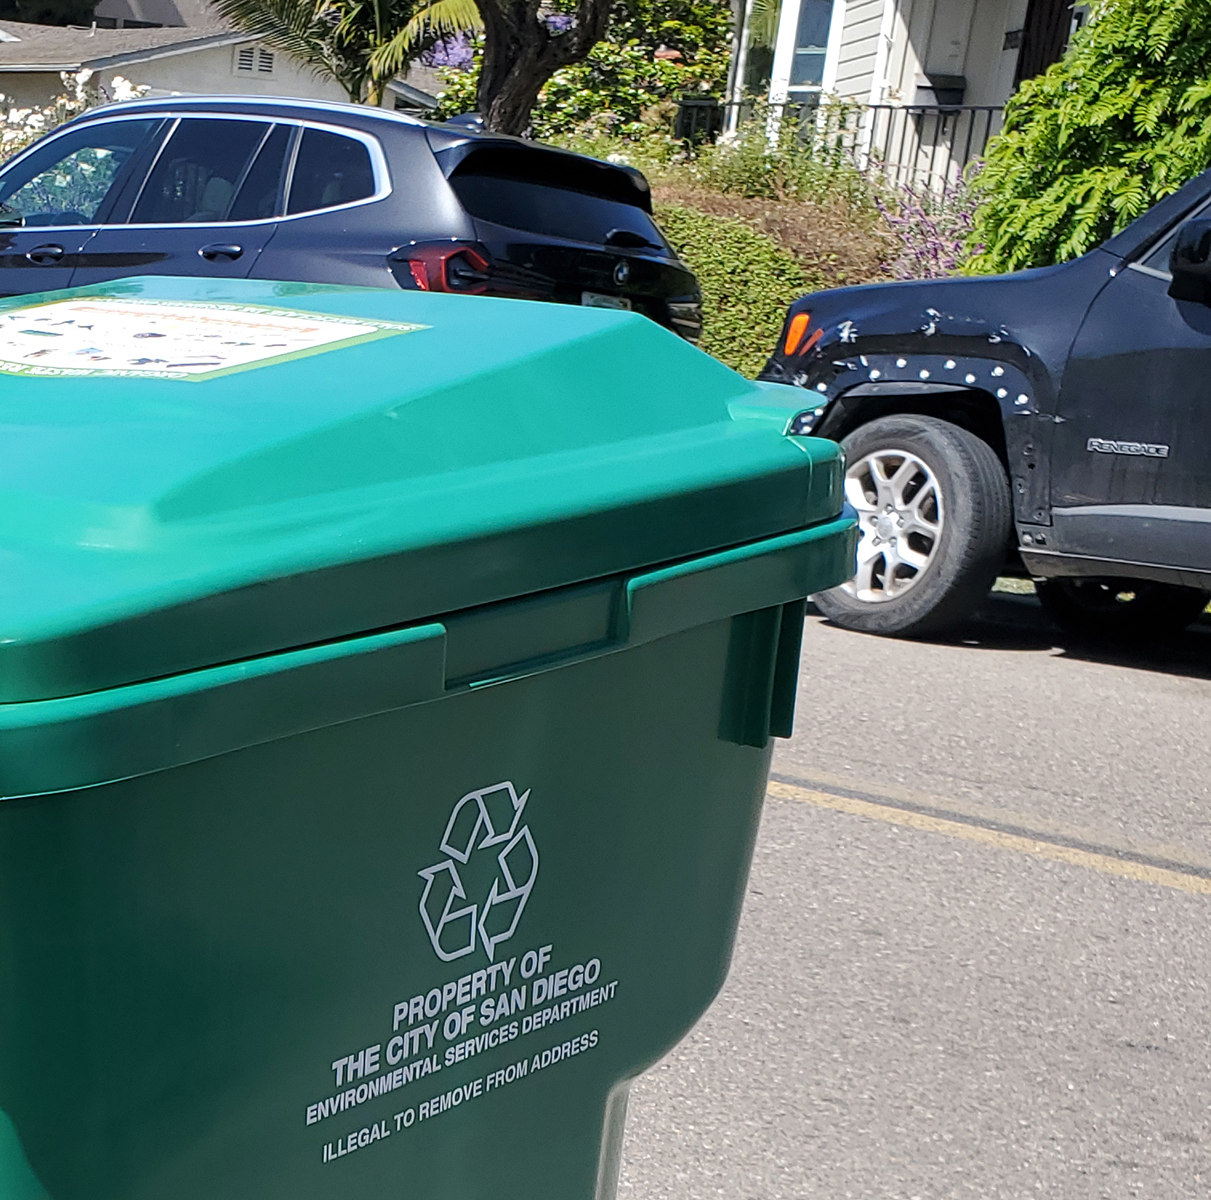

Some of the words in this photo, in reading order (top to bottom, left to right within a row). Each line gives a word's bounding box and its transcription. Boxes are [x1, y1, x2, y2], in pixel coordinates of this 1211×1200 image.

[1087, 438, 1169, 457] RENEGADE
[332, 1044, 381, 1087] THE
[386, 1020, 439, 1066] CITY
[443, 1005, 476, 1041] OF
[479, 986, 527, 1026] SAN
[532, 958, 601, 1003] DIEGO
[392, 957, 516, 1032] PROPERTY
[520, 944, 553, 979] OF
[306, 1054, 441, 1126] ENVIRONMENTAL
[444, 1021, 518, 1066] SERVICES
[522, 981, 618, 1035] DEPARTMENT
[322, 1120, 390, 1164] ILLEGAL
[394, 1108, 415, 1132] TO
[419, 1078, 482, 1122] REMOVE
[486, 1059, 528, 1092] FROM
[531, 1030, 599, 1073] ADDRESS
